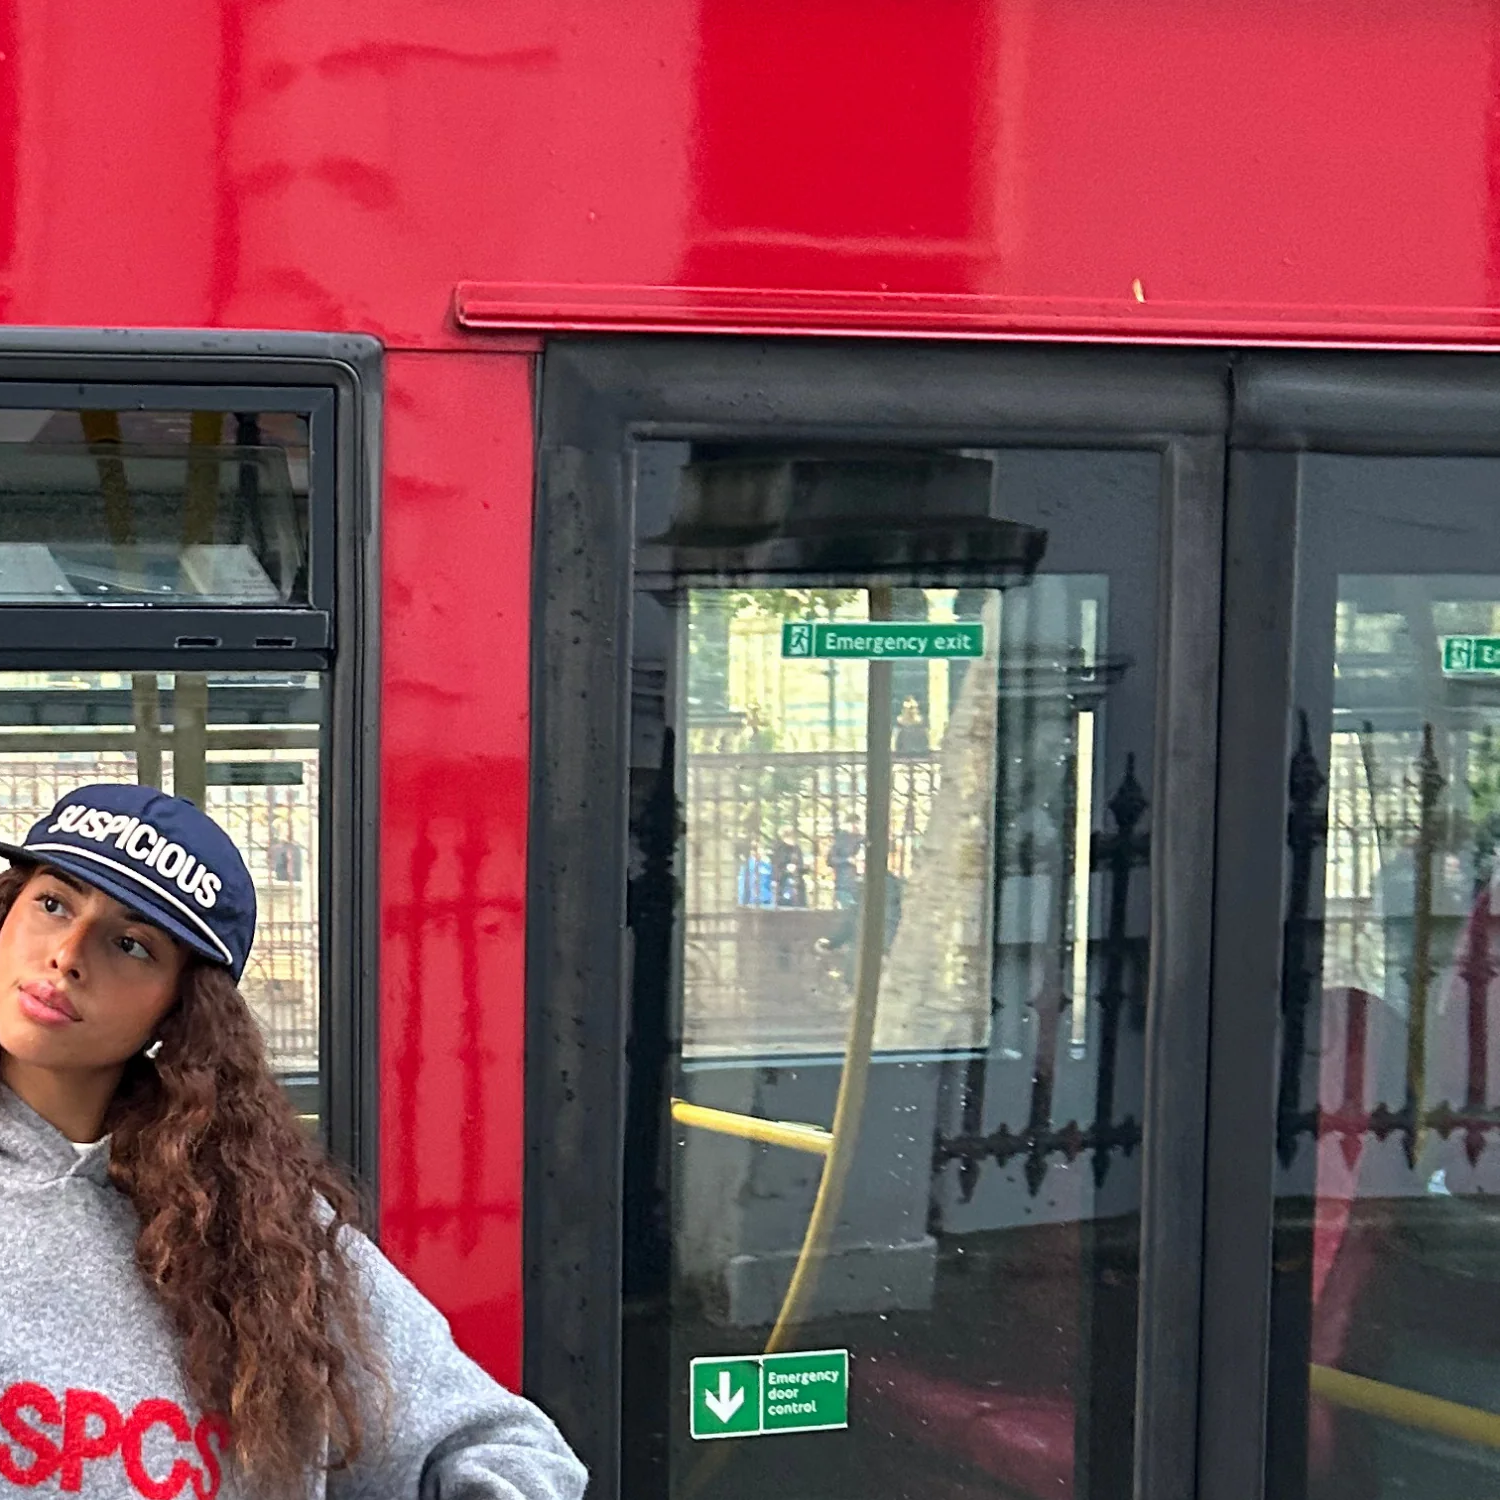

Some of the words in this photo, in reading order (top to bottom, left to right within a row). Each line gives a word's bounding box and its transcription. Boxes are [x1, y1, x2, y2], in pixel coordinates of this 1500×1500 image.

[825, 633, 928, 654] Emergency
[934, 633, 972, 650] exit
[768, 1370, 840, 1385] Emergency
[768, 1387, 799, 1400] door
[768, 1400, 817, 1416] control
